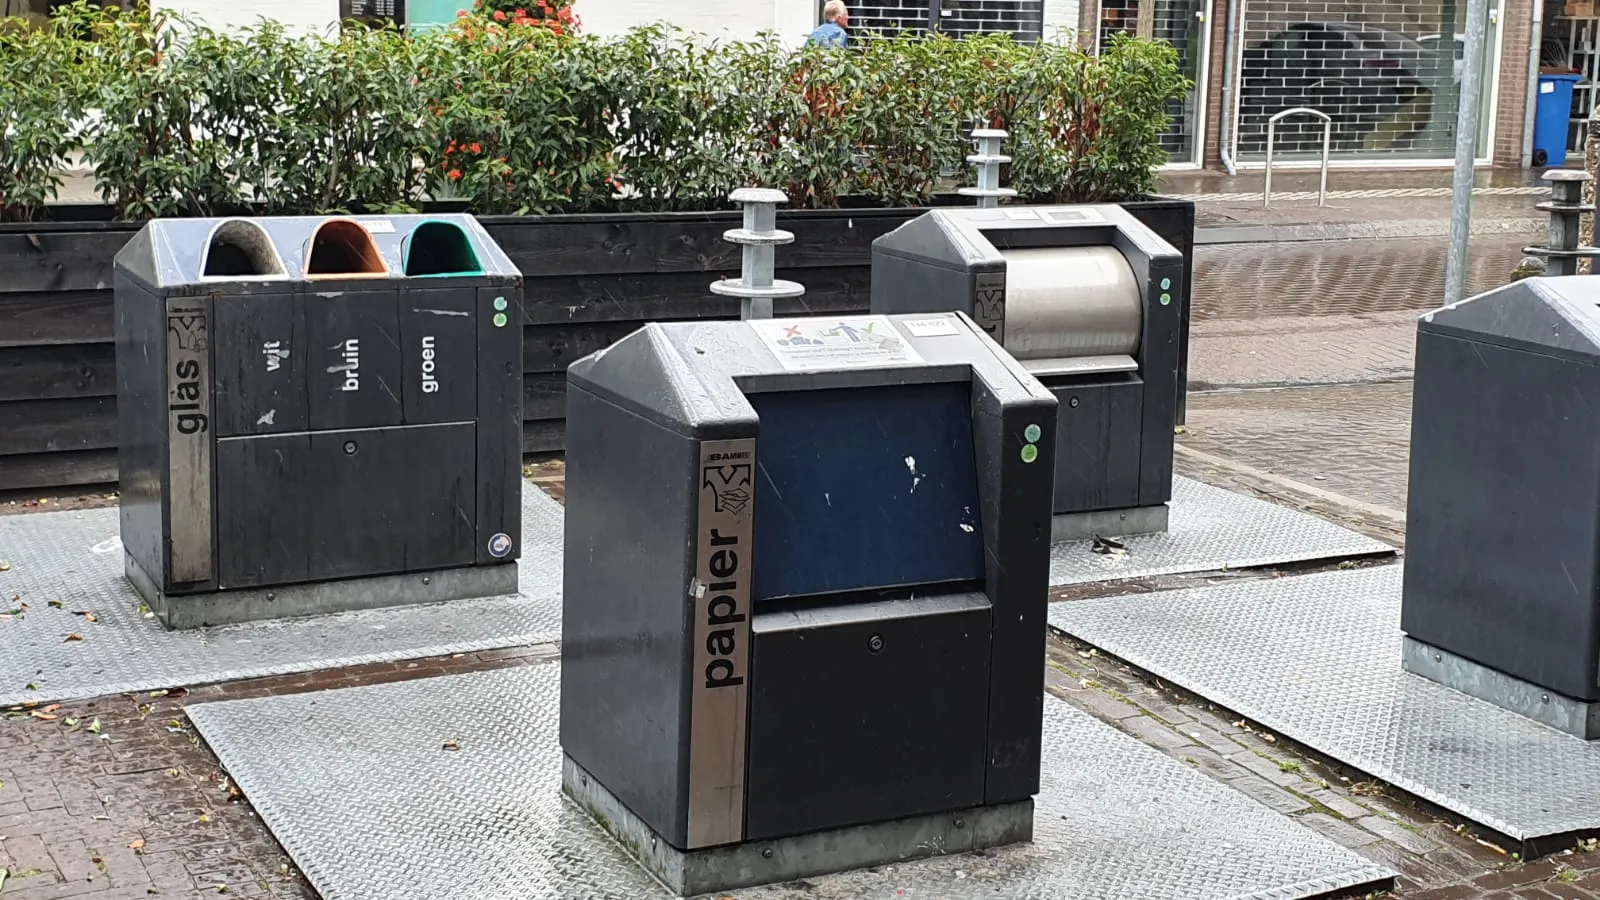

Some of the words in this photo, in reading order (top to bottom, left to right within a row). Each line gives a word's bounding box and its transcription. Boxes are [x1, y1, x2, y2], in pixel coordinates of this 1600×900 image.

[262, 340, 280, 372] wit
[341, 338, 359, 391] bruin
[421, 335, 439, 393] groen
[170, 359, 208, 435] glas
[705, 528, 746, 689] papier
